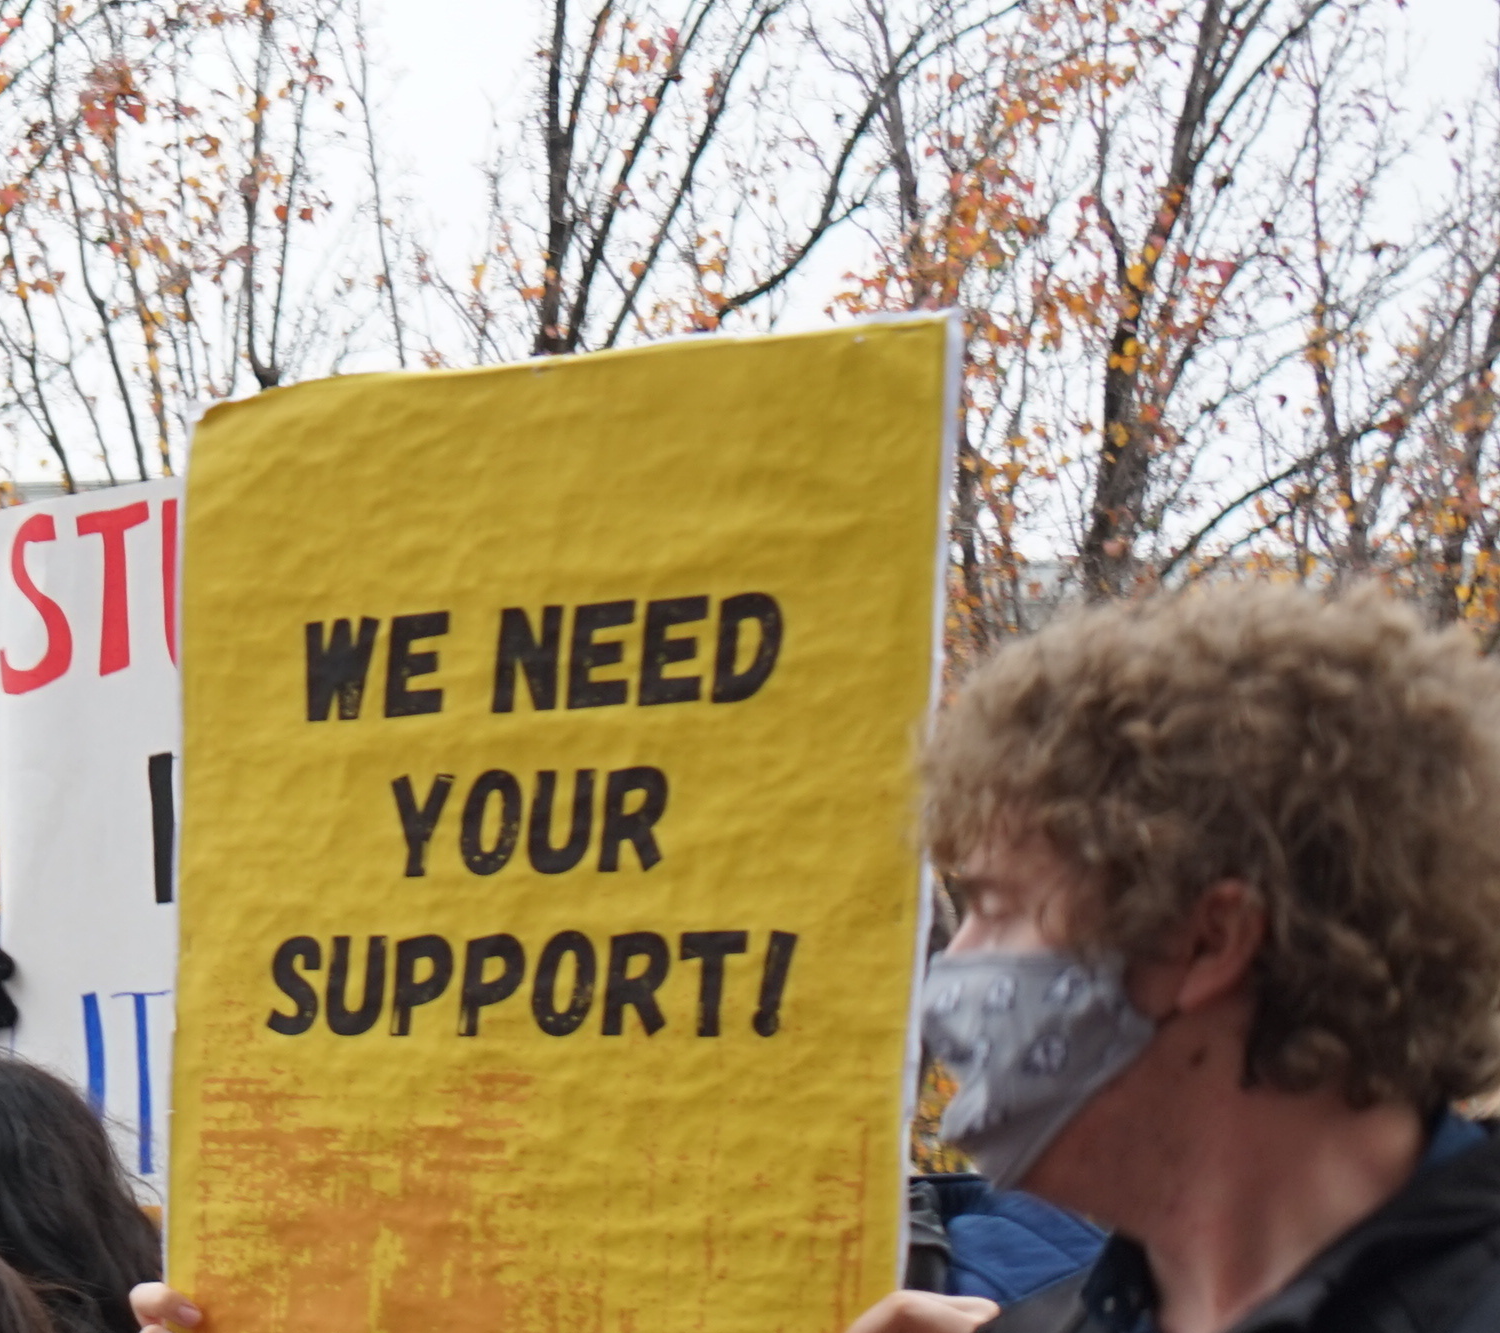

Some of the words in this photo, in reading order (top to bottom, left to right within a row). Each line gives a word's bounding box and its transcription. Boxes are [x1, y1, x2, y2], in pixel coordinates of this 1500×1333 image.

[305, 611, 450, 722] WE
[491, 592, 784, 714] NEED
[391, 766, 669, 878] YOUR
[266, 930, 798, 1038] SUPPORT!
